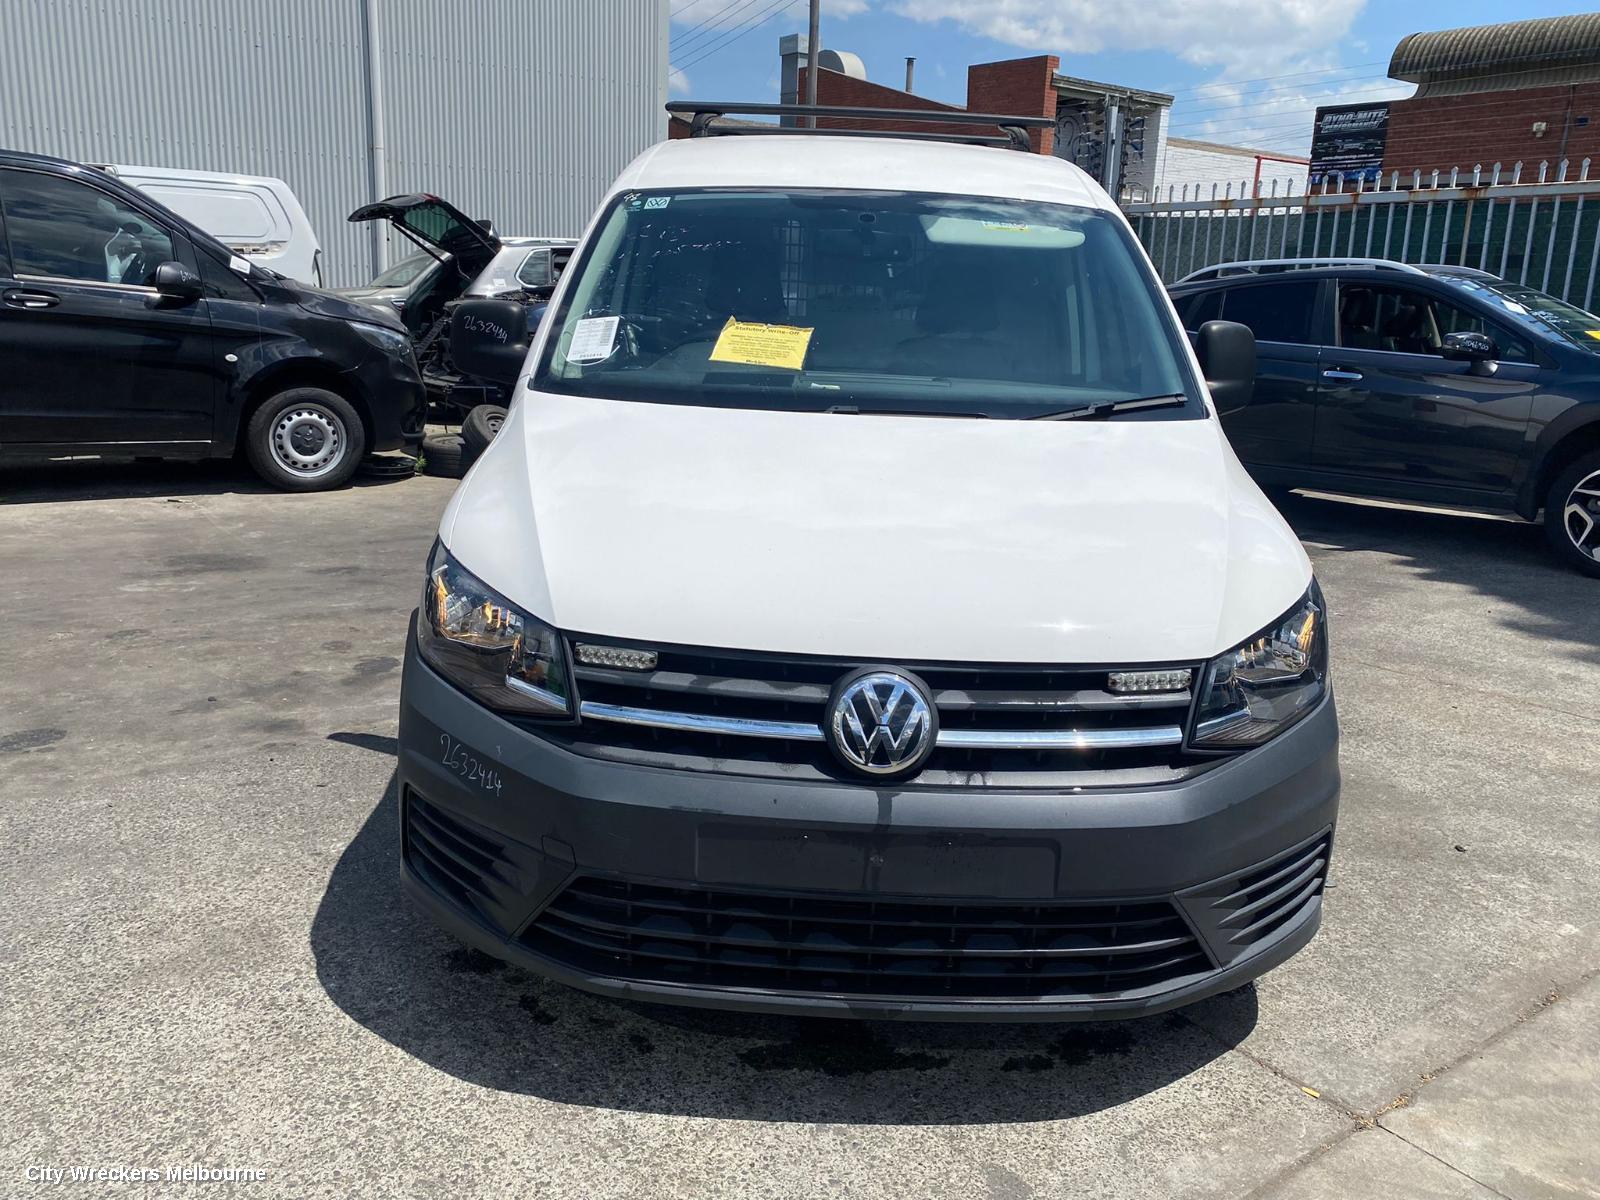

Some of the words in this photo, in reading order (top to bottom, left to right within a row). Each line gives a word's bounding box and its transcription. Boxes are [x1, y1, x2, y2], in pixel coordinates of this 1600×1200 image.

[463, 315, 508, 344] 2632414
[735, 325, 766, 333] Statutory
[835, 673, 931, 773] VW
[440, 733, 502, 797] 2632414
